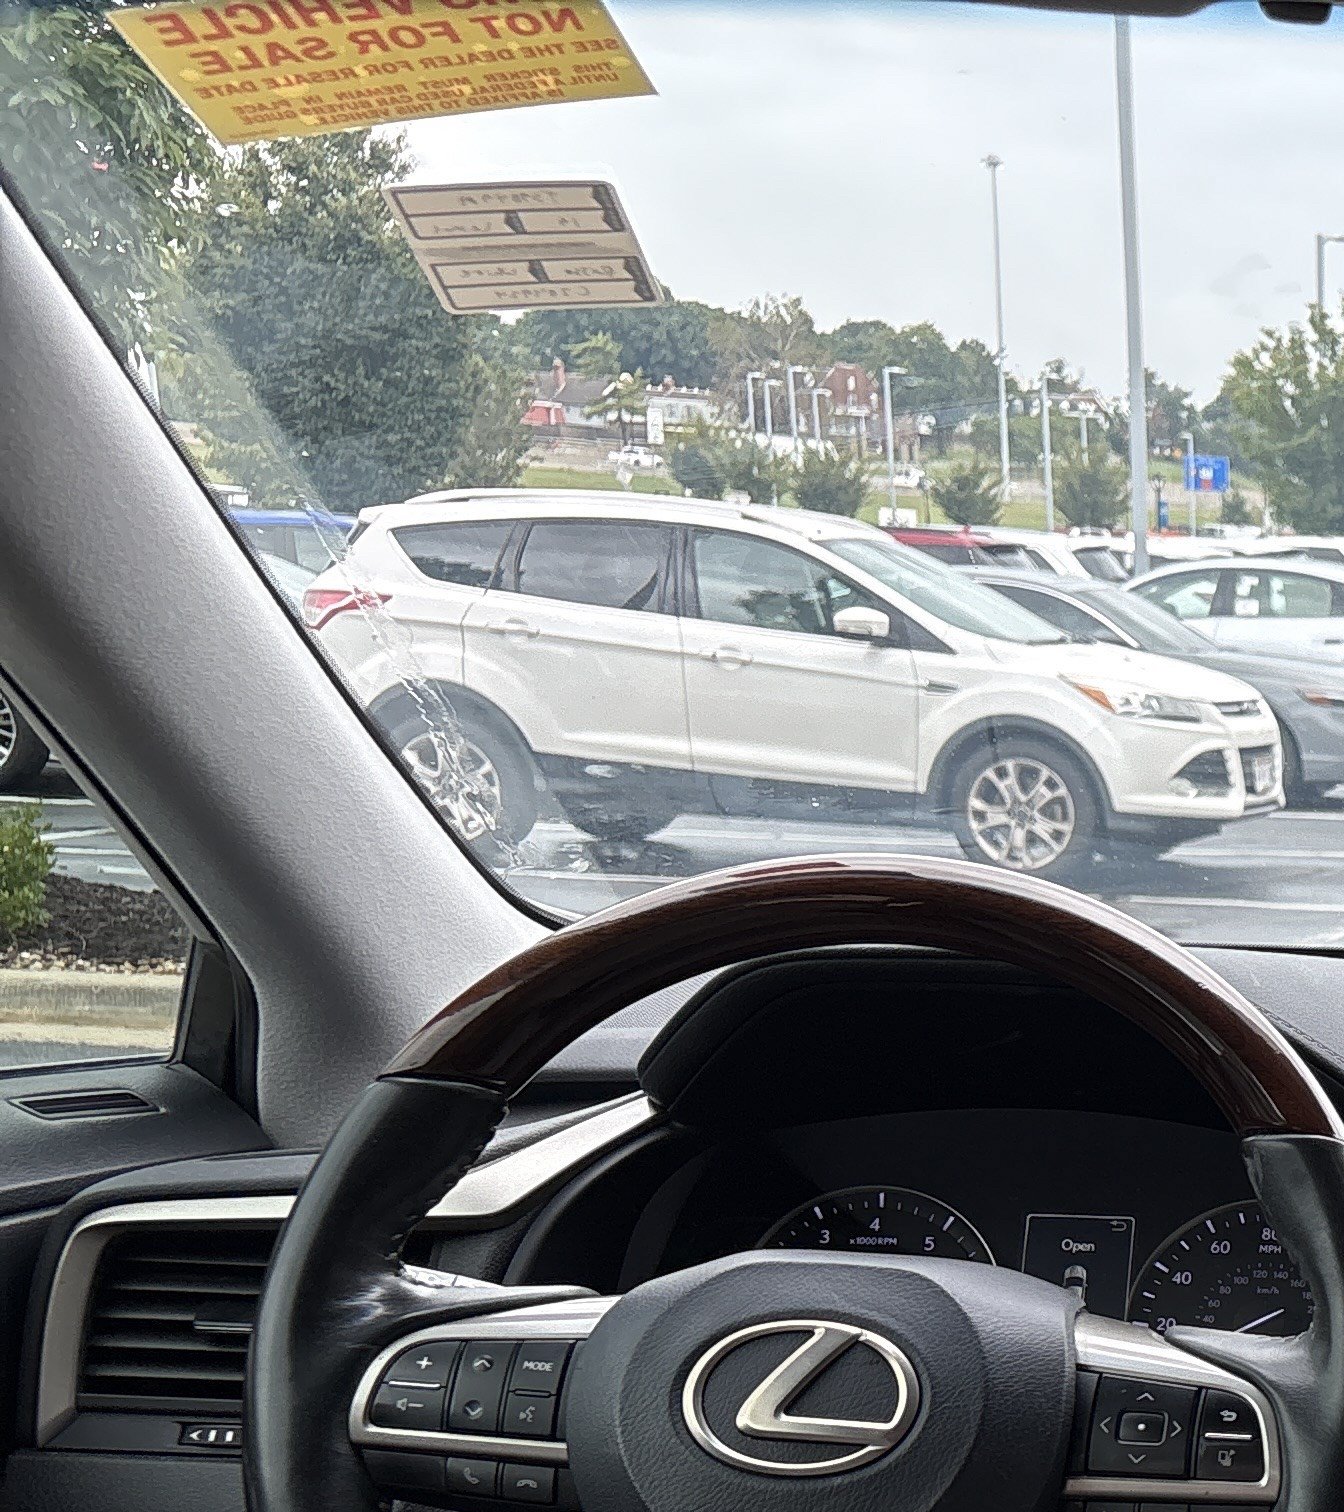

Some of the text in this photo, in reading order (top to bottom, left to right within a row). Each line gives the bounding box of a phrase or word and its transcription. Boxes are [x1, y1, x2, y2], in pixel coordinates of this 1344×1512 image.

[869, 1217, 881, 1231] 4
[819, 1230, 831, 1245] 3
[923, 1237, 934, 1251] 5
[1061, 1239, 1095, 1254] Open
[1211, 1241, 1231, 1254] 60
[1259, 1245, 1282, 1254] MPH
[1172, 1271, 1192, 1285] 40
[1253, 1270, 1268, 1278] 120
[1233, 1276, 1249, 1285] 100
[1219, 1286, 1232, 1295] 80
[1256, 1286, 1280, 1295] km/h
[523, 1361, 553, 1372] MODE
